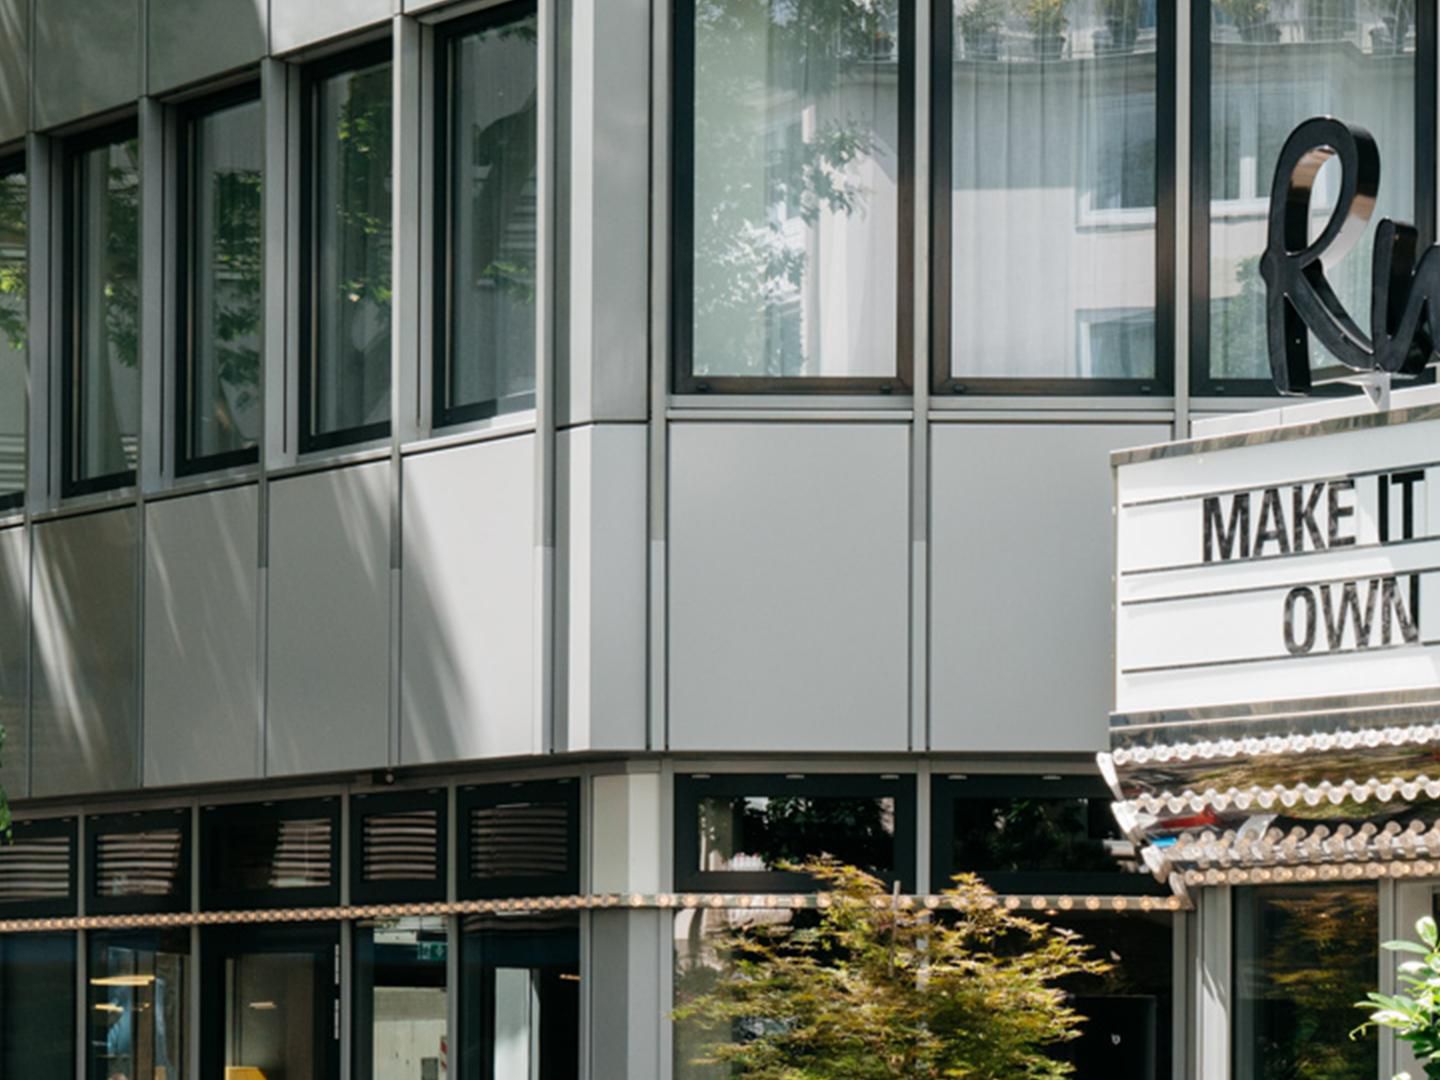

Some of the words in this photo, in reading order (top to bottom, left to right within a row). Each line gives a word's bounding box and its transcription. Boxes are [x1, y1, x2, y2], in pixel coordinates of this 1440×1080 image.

[1203, 479, 1356, 564] MAKE
[1378, 469, 1425, 544] IT
[1284, 574, 1420, 655] OWN
